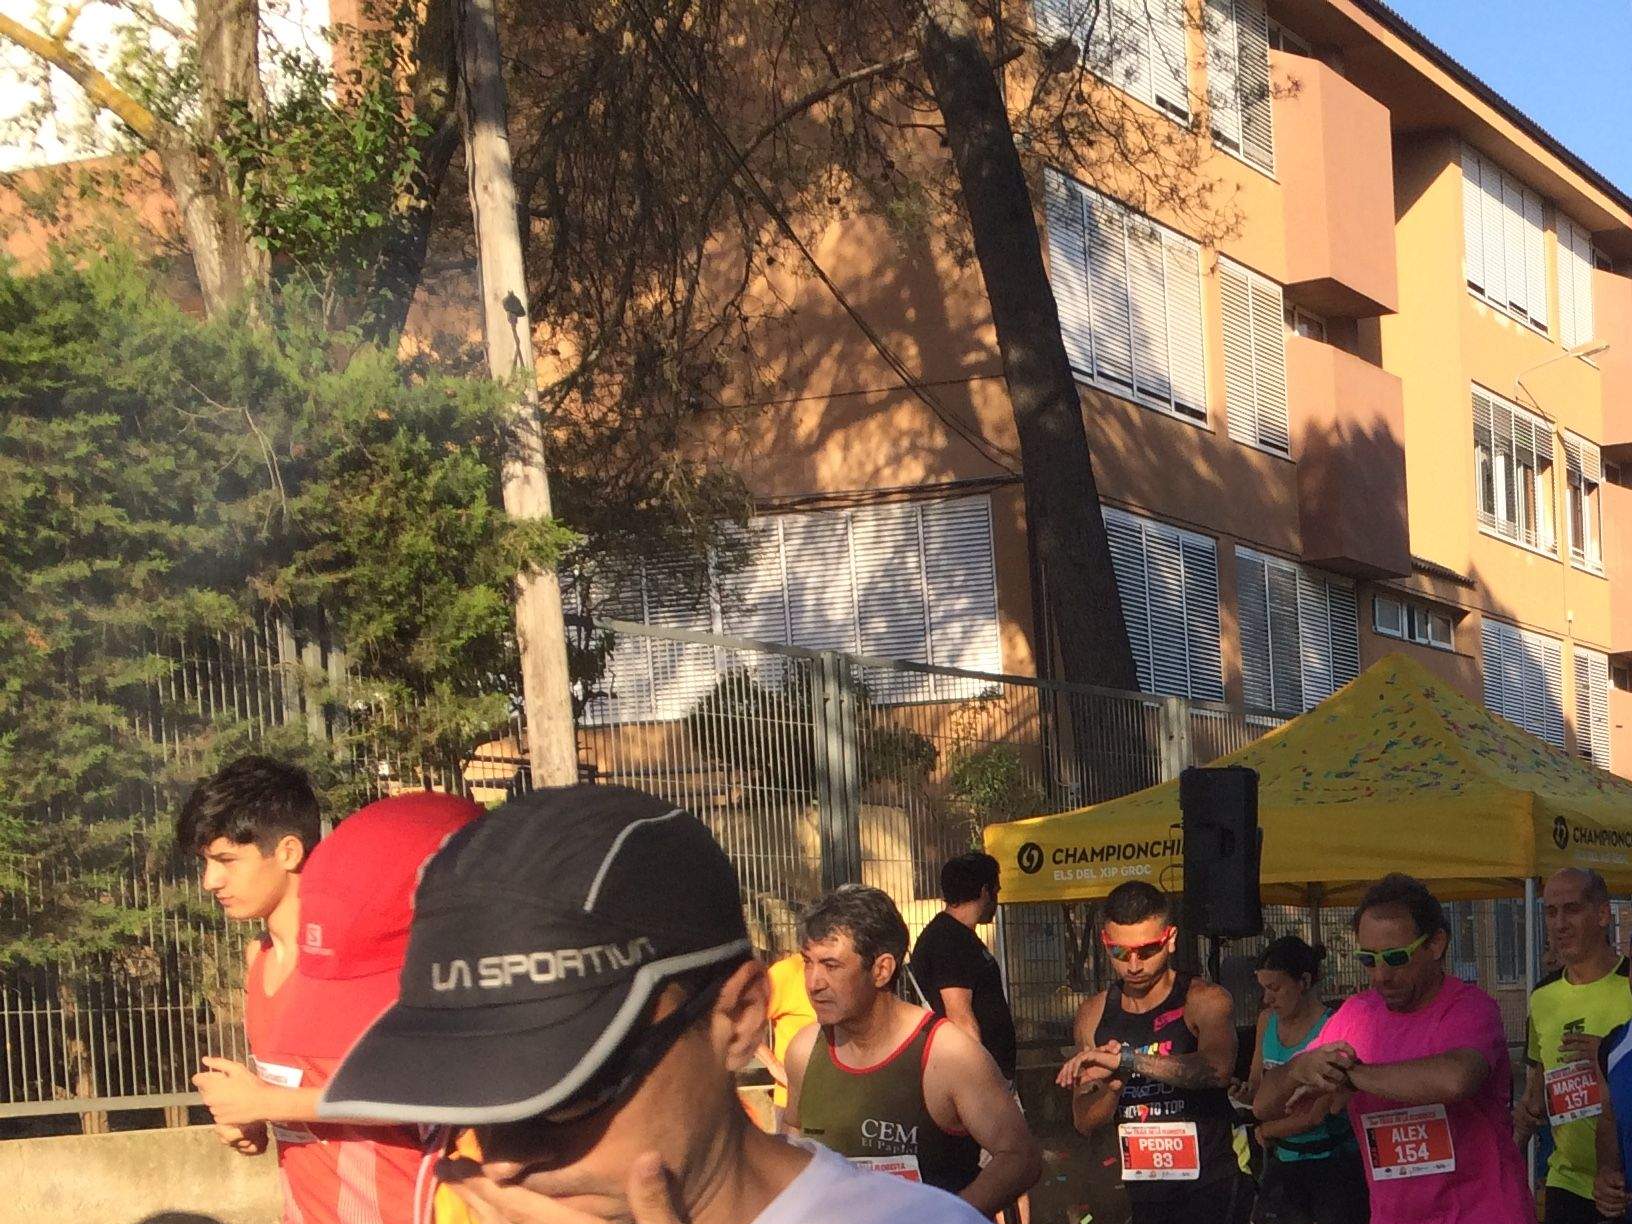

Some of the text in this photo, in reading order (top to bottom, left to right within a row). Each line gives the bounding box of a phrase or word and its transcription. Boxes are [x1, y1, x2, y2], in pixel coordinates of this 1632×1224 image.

[1052, 840, 1185, 865] CHAMPIONCHI
[1053, 864, 1153, 881] ELS DEL XIP GROC
[432, 936, 656, 991] LA SPORTIVA
[1553, 1073, 1597, 1096] MARÇAL
[1565, 1090, 1588, 1110] 157
[861, 1118, 919, 1145] CEM
[1392, 1124, 1428, 1143] ALEX
[1138, 1138, 1184, 1151] PEDRO
[1394, 1142, 1429, 1163] 154
[1152, 1152, 1174, 1168] 83
